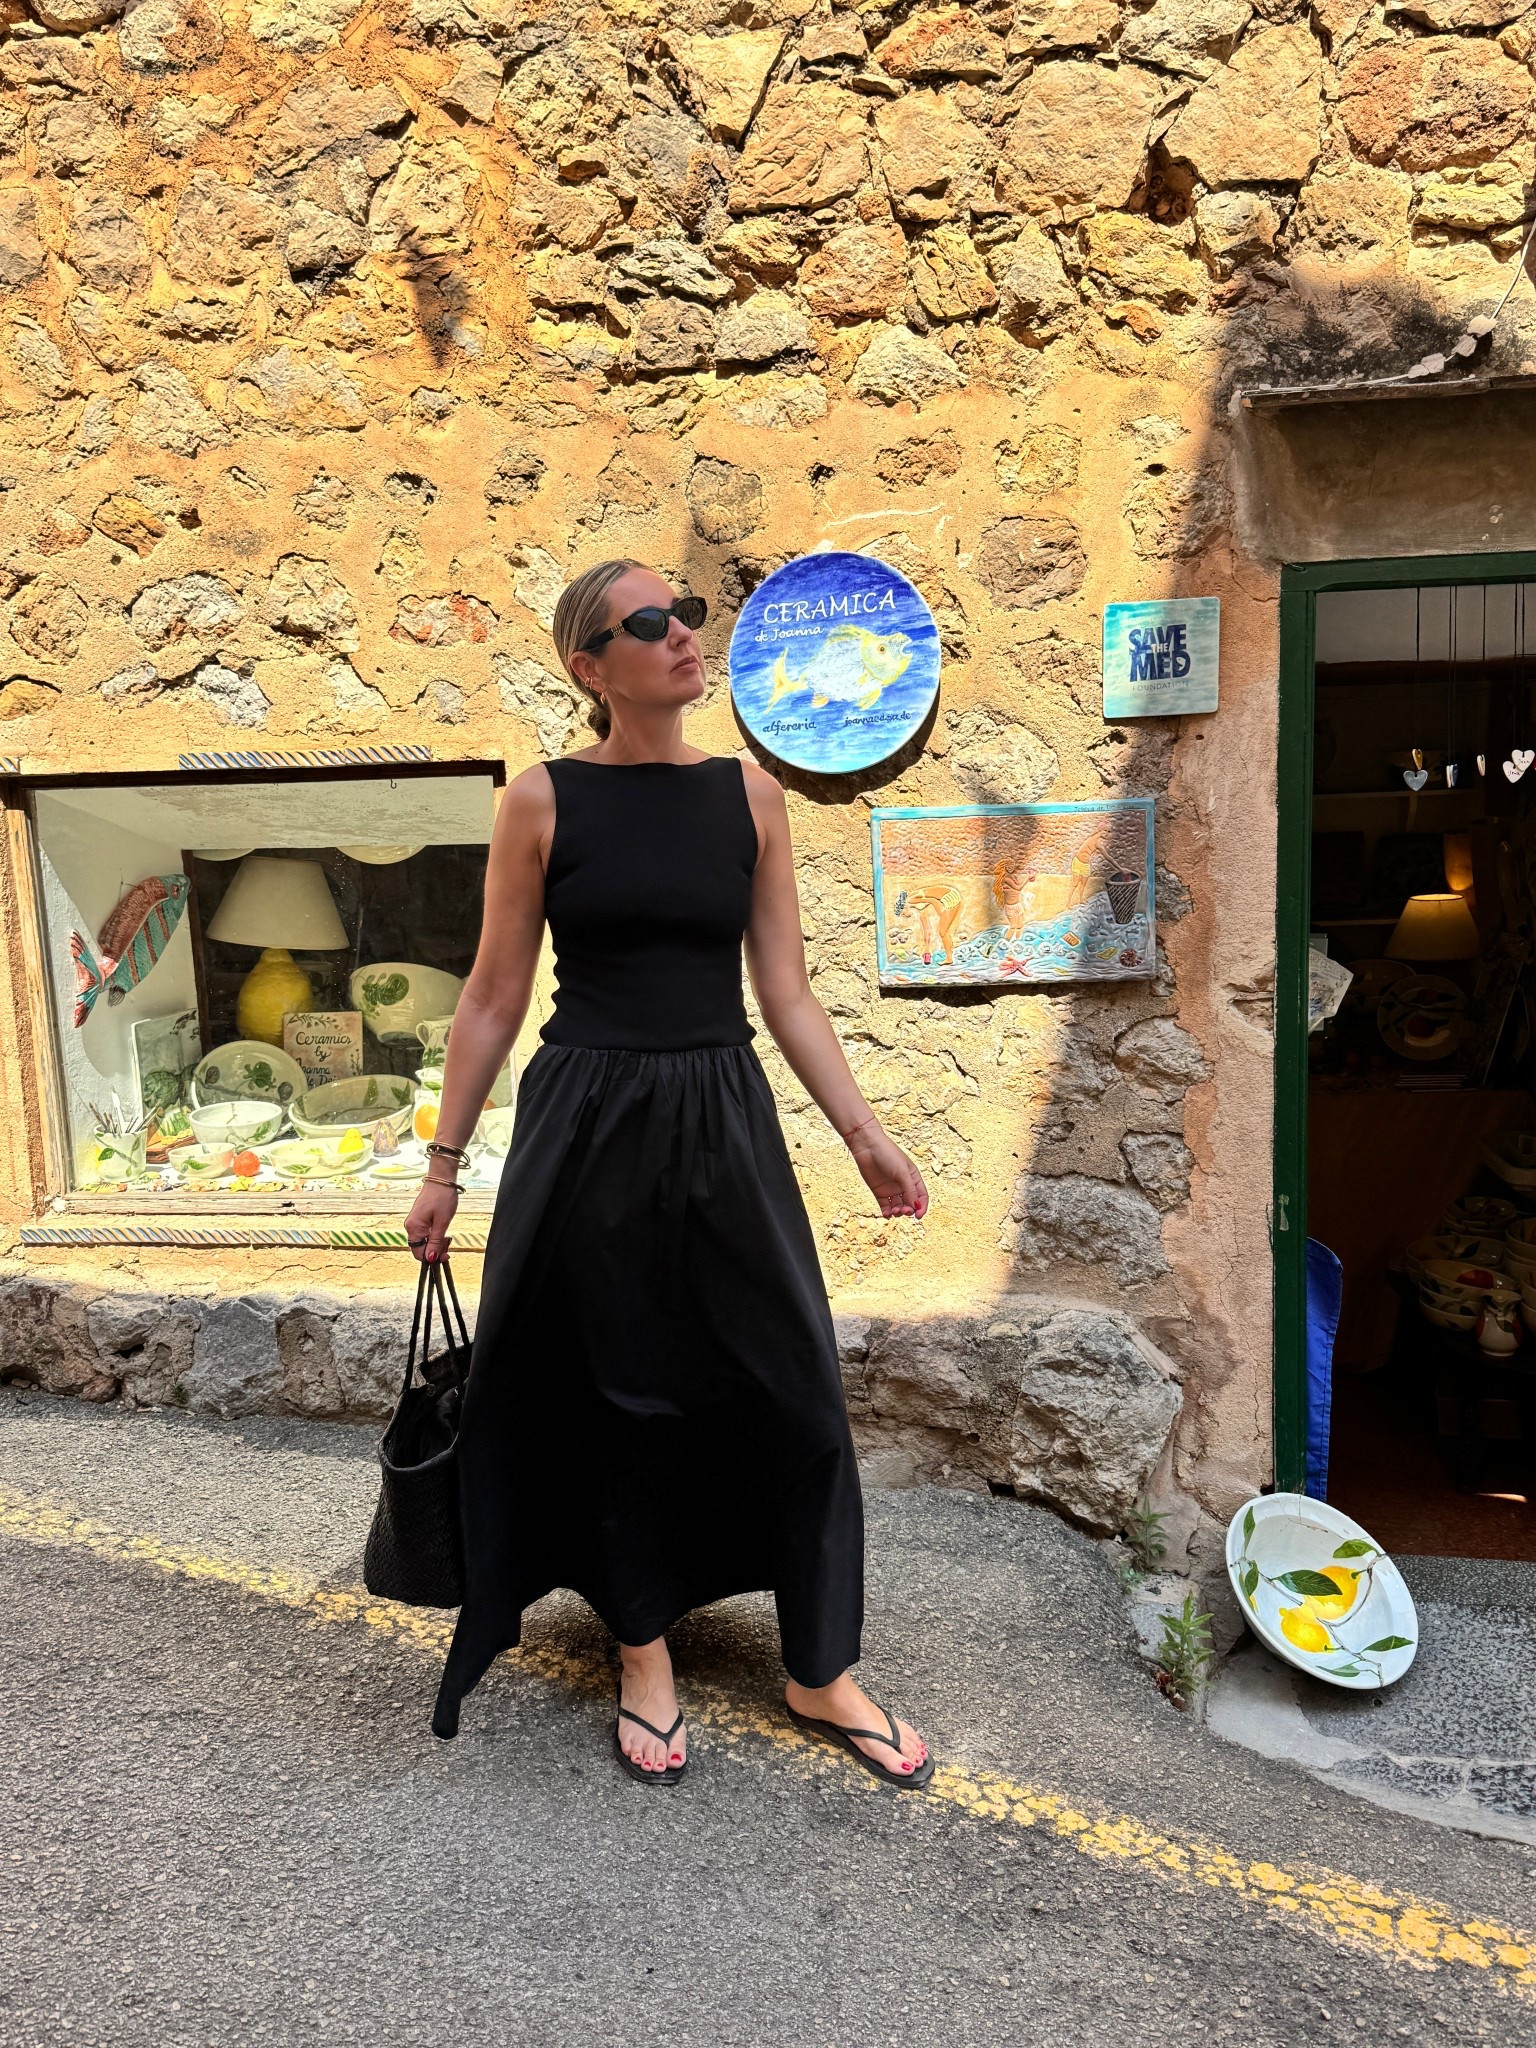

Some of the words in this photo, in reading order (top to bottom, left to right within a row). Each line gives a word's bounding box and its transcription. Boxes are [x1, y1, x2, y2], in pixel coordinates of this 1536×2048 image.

[764, 589, 896, 623] CERAMICA
[755, 629, 768, 643] de
[771, 627, 824, 642] Joanna
[1128, 624, 1187, 653] SAVE
[1151, 643, 1169, 653] THE
[1129, 650, 1191, 683] MED
[1133, 680, 1189, 692] FOUNDATION
[296, 1031, 352, 1045] Ceramics
[314, 1046, 331, 1062] by
